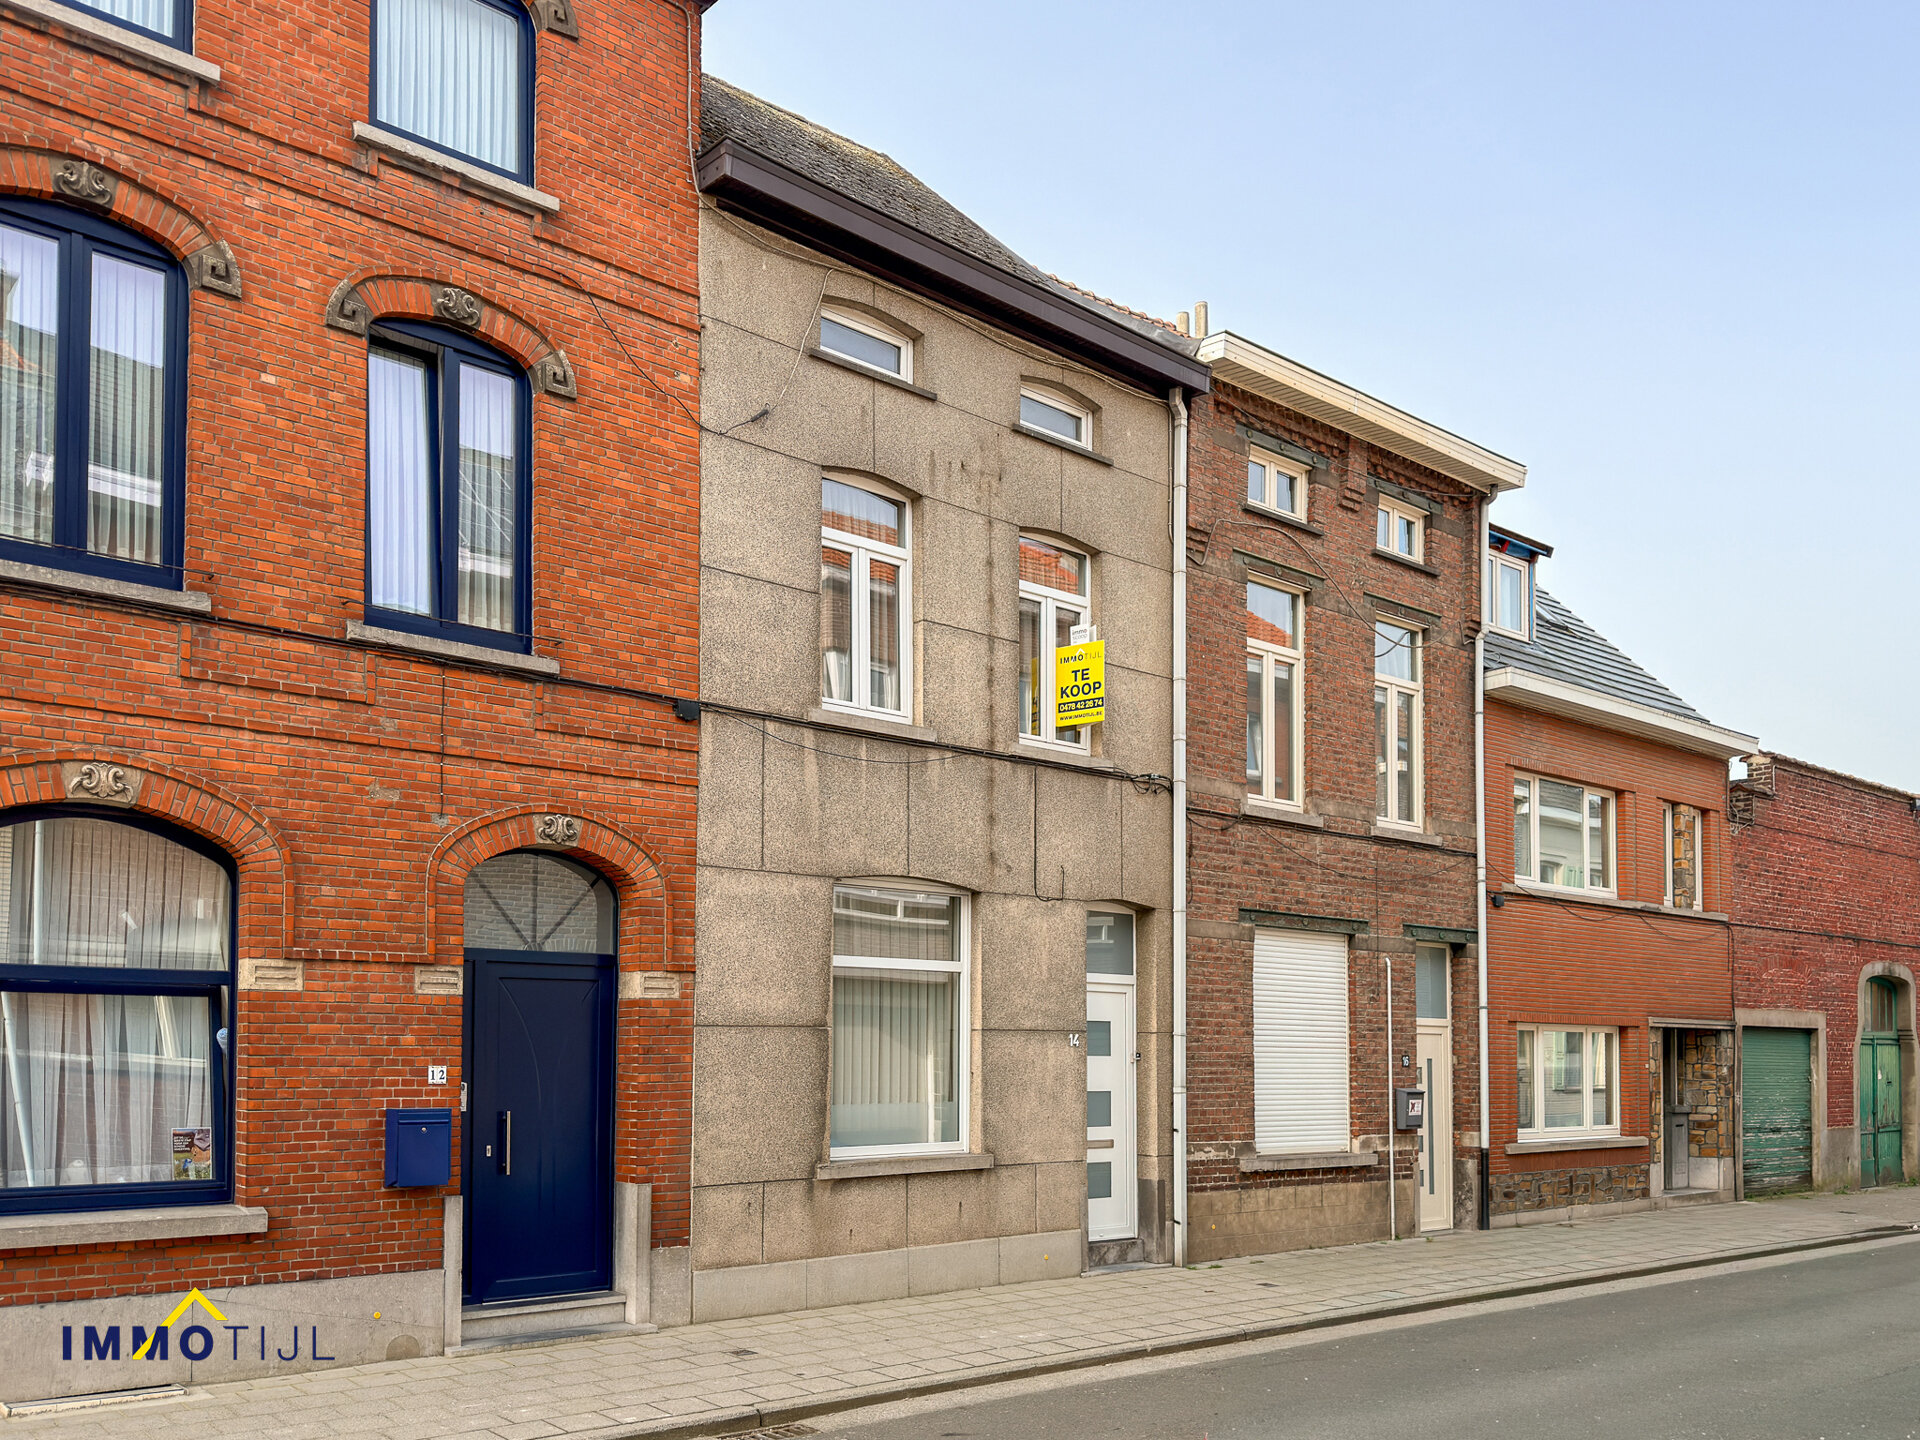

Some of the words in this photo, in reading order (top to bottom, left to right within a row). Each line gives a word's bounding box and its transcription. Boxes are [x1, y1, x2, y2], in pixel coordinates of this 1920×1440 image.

[1060, 651, 1102, 664] IMMOTIJL
[1071, 668, 1090, 682] TE
[1060, 681, 1102, 699] KOOP
[1059, 703, 1076, 712] 0478
[1076, 701, 1085, 709] 42
[1094, 698, 1103, 707] 74
[1068, 1033, 1080, 1047] 14
[430, 1069, 445, 1080] 12
